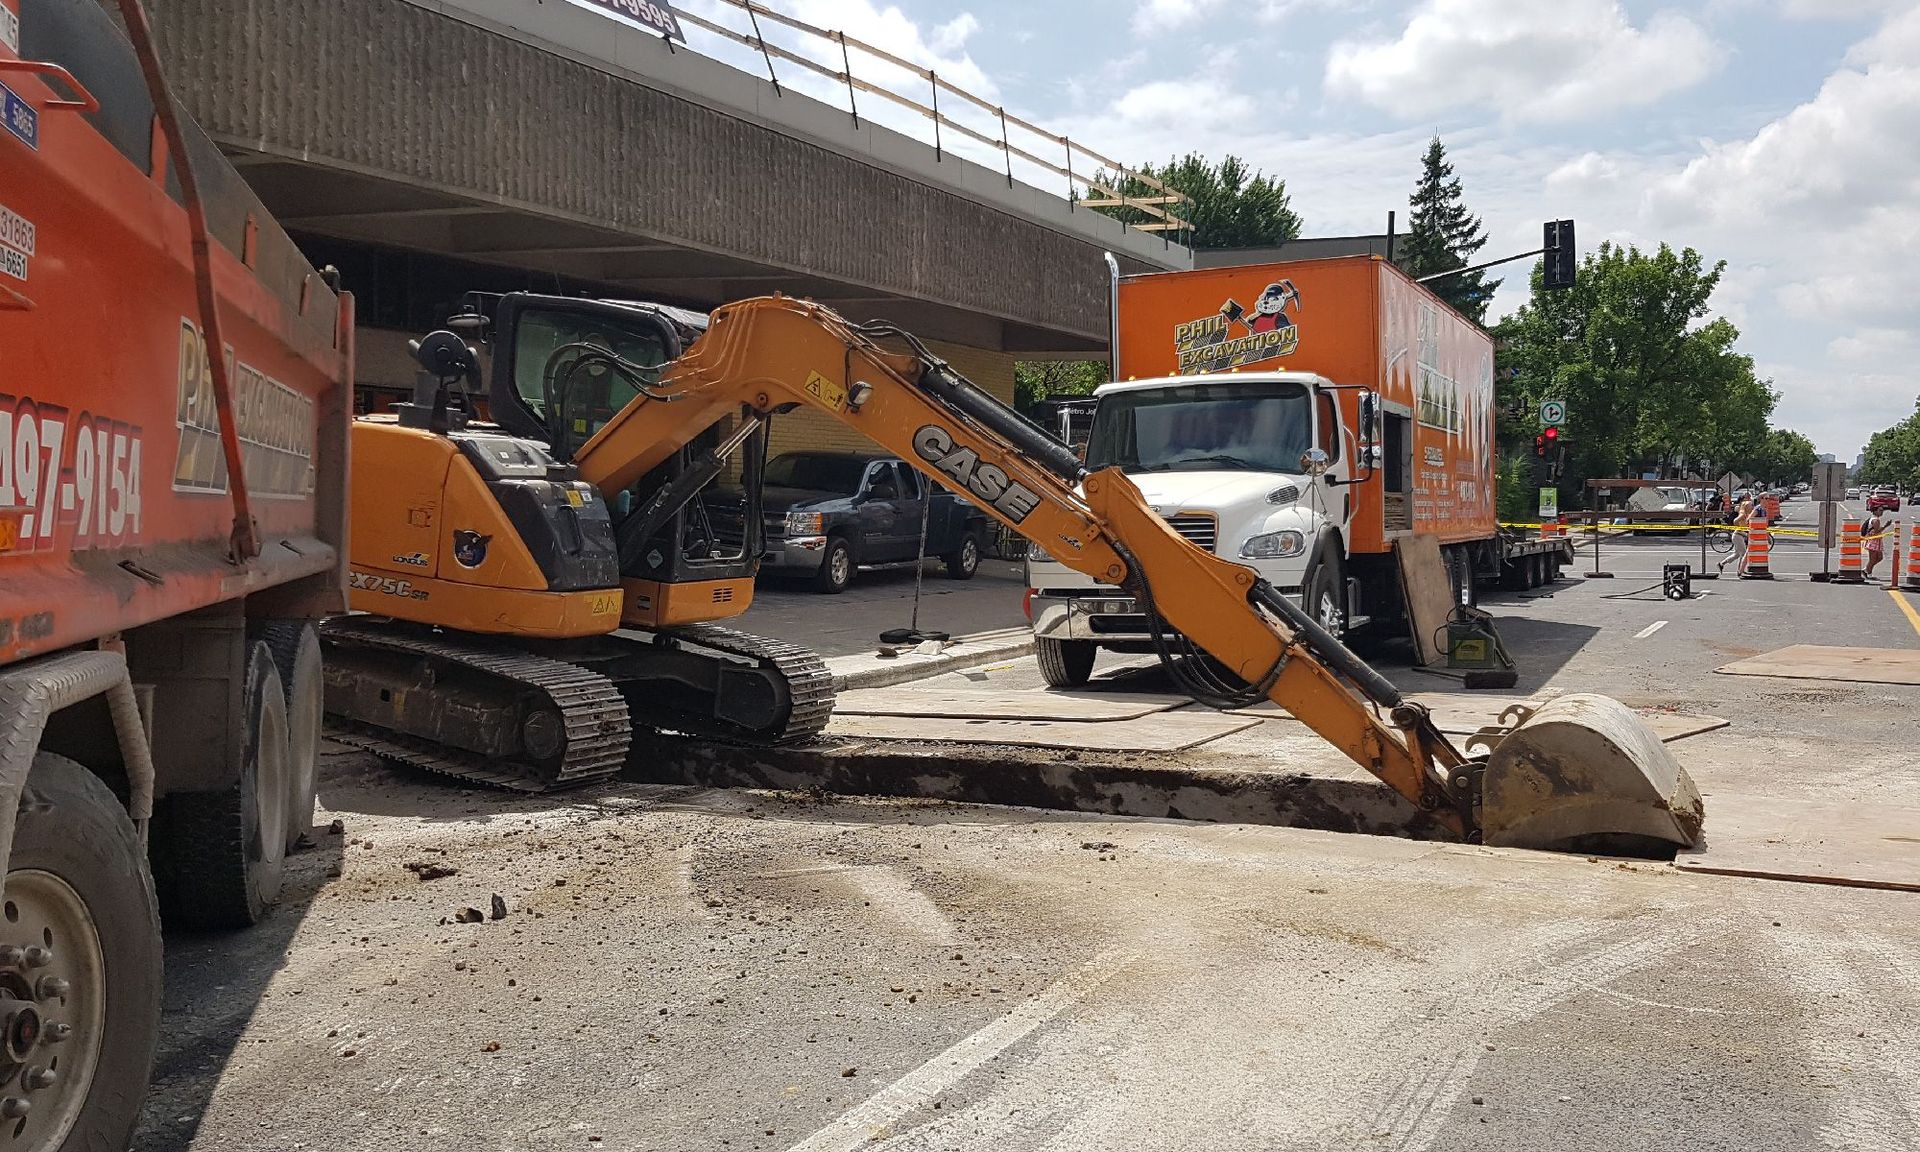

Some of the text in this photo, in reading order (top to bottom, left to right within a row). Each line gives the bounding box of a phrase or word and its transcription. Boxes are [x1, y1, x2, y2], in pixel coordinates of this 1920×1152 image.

[1176, 316, 1226, 342] PHIL
[1180, 325, 1297, 367] EXCAVATION
[912, 425, 1041, 525] CASE
